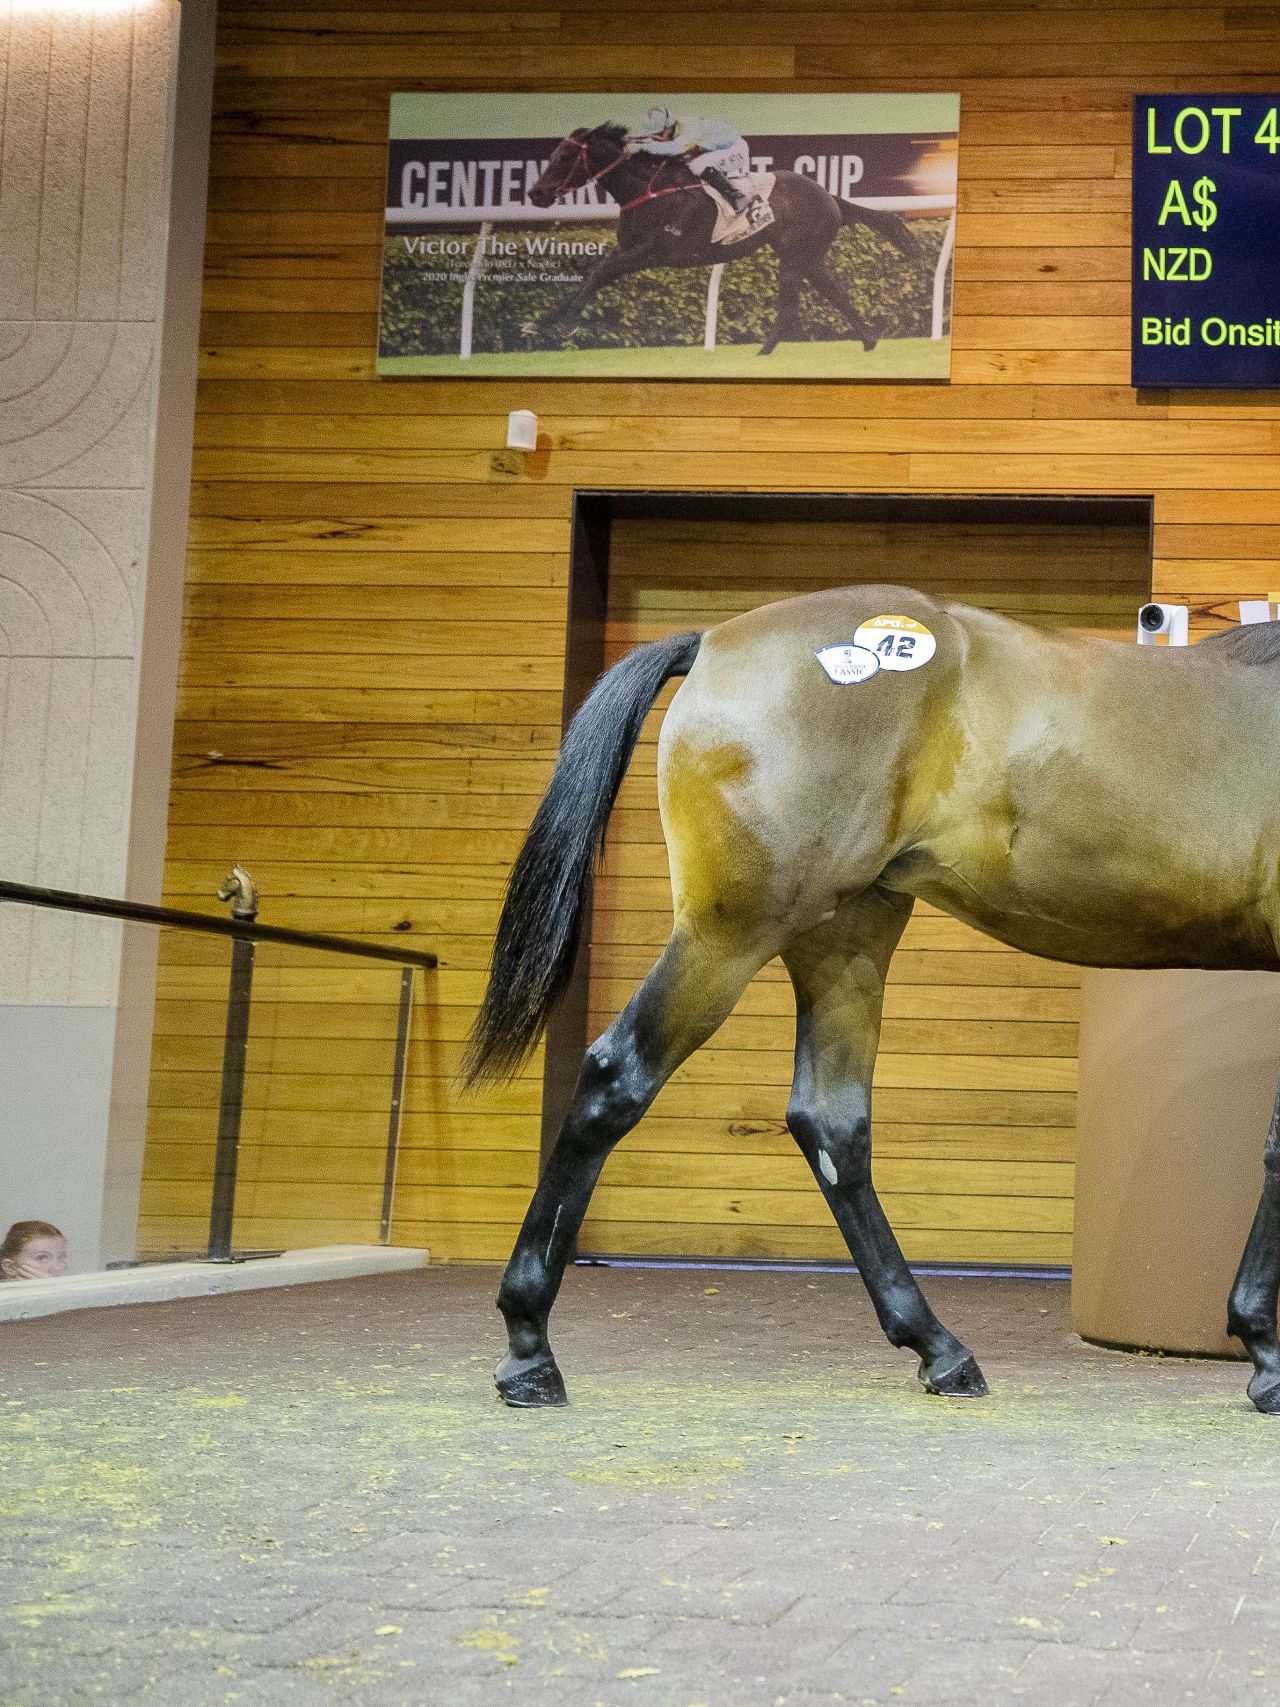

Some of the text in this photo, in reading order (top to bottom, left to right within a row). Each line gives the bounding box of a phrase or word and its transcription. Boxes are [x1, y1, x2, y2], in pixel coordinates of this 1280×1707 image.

[1147, 107, 1242, 154] LOT
[1158, 176, 1218, 231] A$
[403, 234, 609, 256] Victor The Winner
[1143, 248, 1213, 281] NZD
[1142, 317, 1190, 346] Bid
